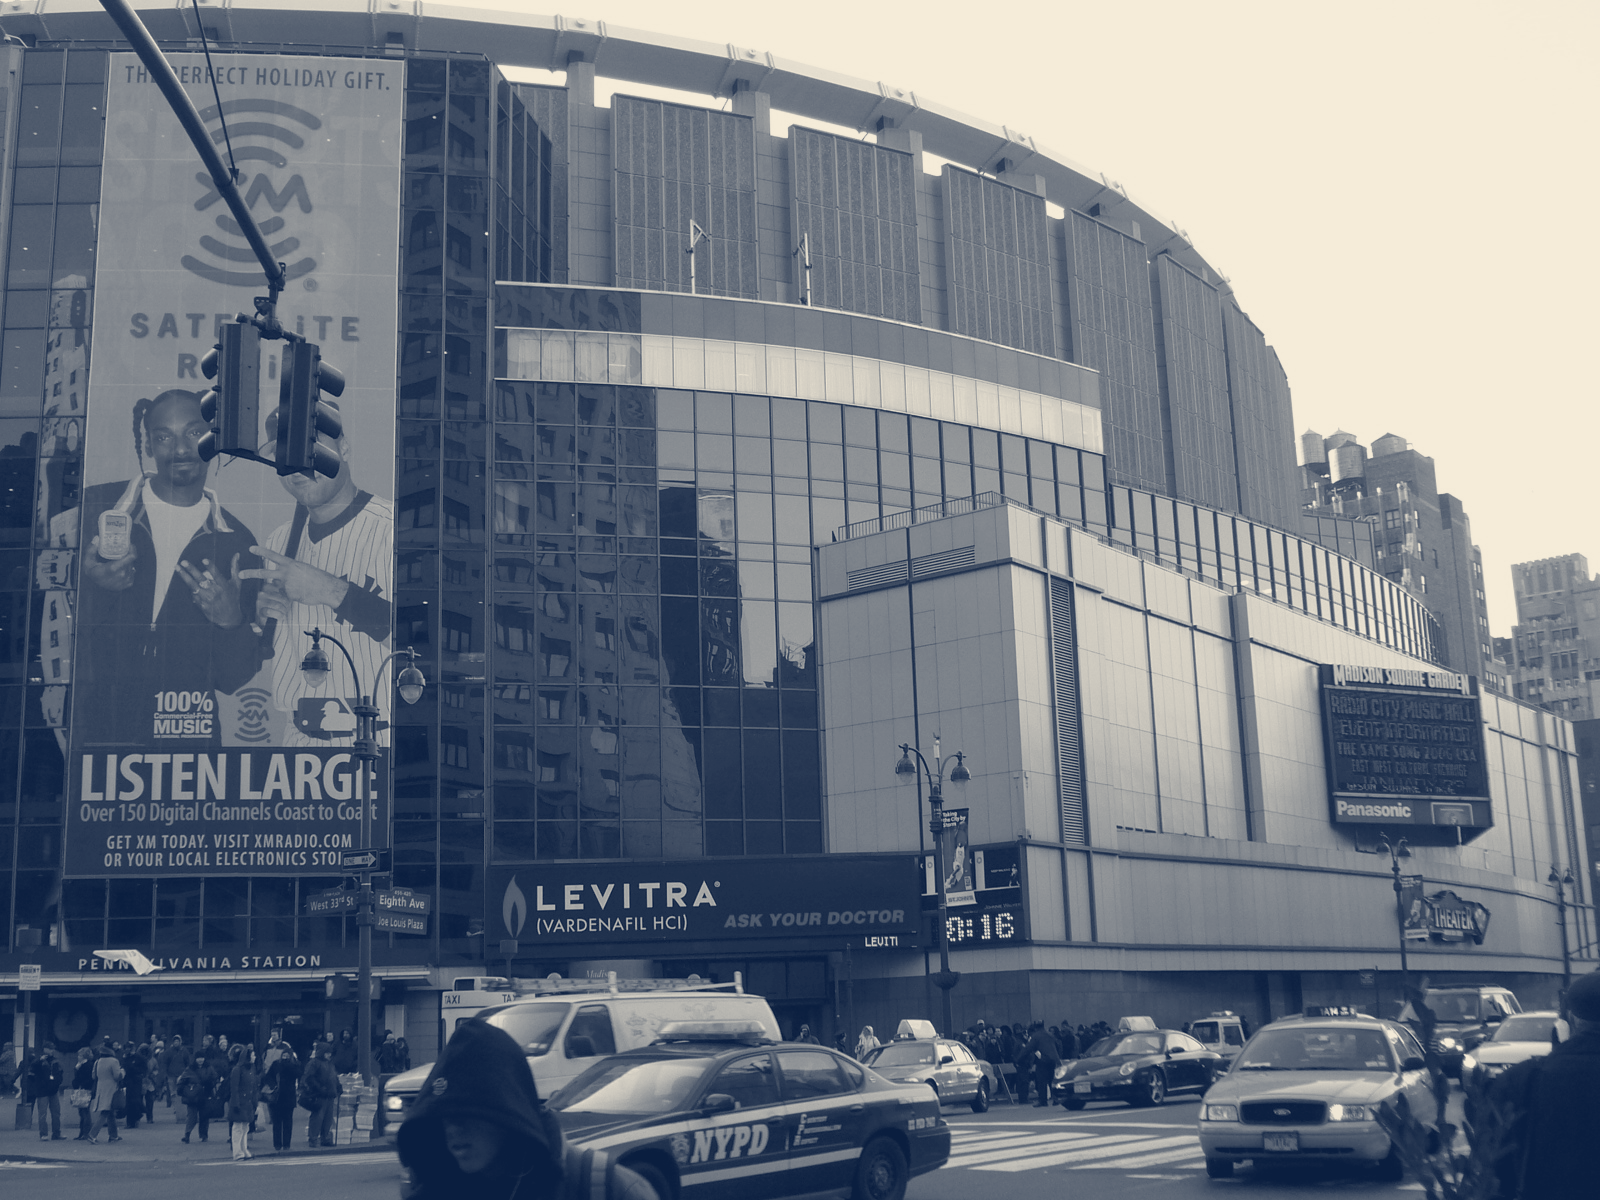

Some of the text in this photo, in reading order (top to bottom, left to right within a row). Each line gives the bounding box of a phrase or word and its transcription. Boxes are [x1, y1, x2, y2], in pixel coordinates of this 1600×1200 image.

[256, 68, 337, 88] HOLIDAY
[344, 71, 390, 91] GIFT.
[1332, 664, 1471, 696] MADISON SQUARE GARDEN
[154, 691, 214, 712] 100%
[1371, 698, 1400, 718] CITY
[1403, 700, 1442, 720] MUSIC
[1443, 702, 1474, 722] HALL
[237, 709, 270, 721] XM
[153, 719, 213, 734] MUSIC
[1337, 741, 1357, 756] THE
[1360, 743, 1389, 758] SAME
[1392, 744, 1421, 759] SONG
[80, 753, 227, 802] LISTEN
[80, 802, 378, 826] Over 150 Digital Channels Coast to Coat
[1336, 800, 1412, 818] Panasonic
[107, 833, 352, 850] GET XM TODAY. VISIT XMRADIO.COM
[104, 851, 342, 867] OR YOUR LOCAL ELECTRONICS STO
[310, 895, 354, 911] West 33rd St
[379, 895, 425, 909] Eighth Ave
[536, 880, 717, 911] LEVITRA
[378, 916, 424, 930] Joe Louis Plaza
[536, 916, 647, 935] (VARDENAFIL
[724, 909, 905, 928] ASK YOUR DOCTOR
[1432, 903, 1474, 930] THEATER
[864, 936, 898, 947] LEVIT
[78, 955, 320, 970] PENNLVANIA STATION
[444, 994, 517, 1004] TAXI TAX
[689, 1123, 770, 1164] NYPD
